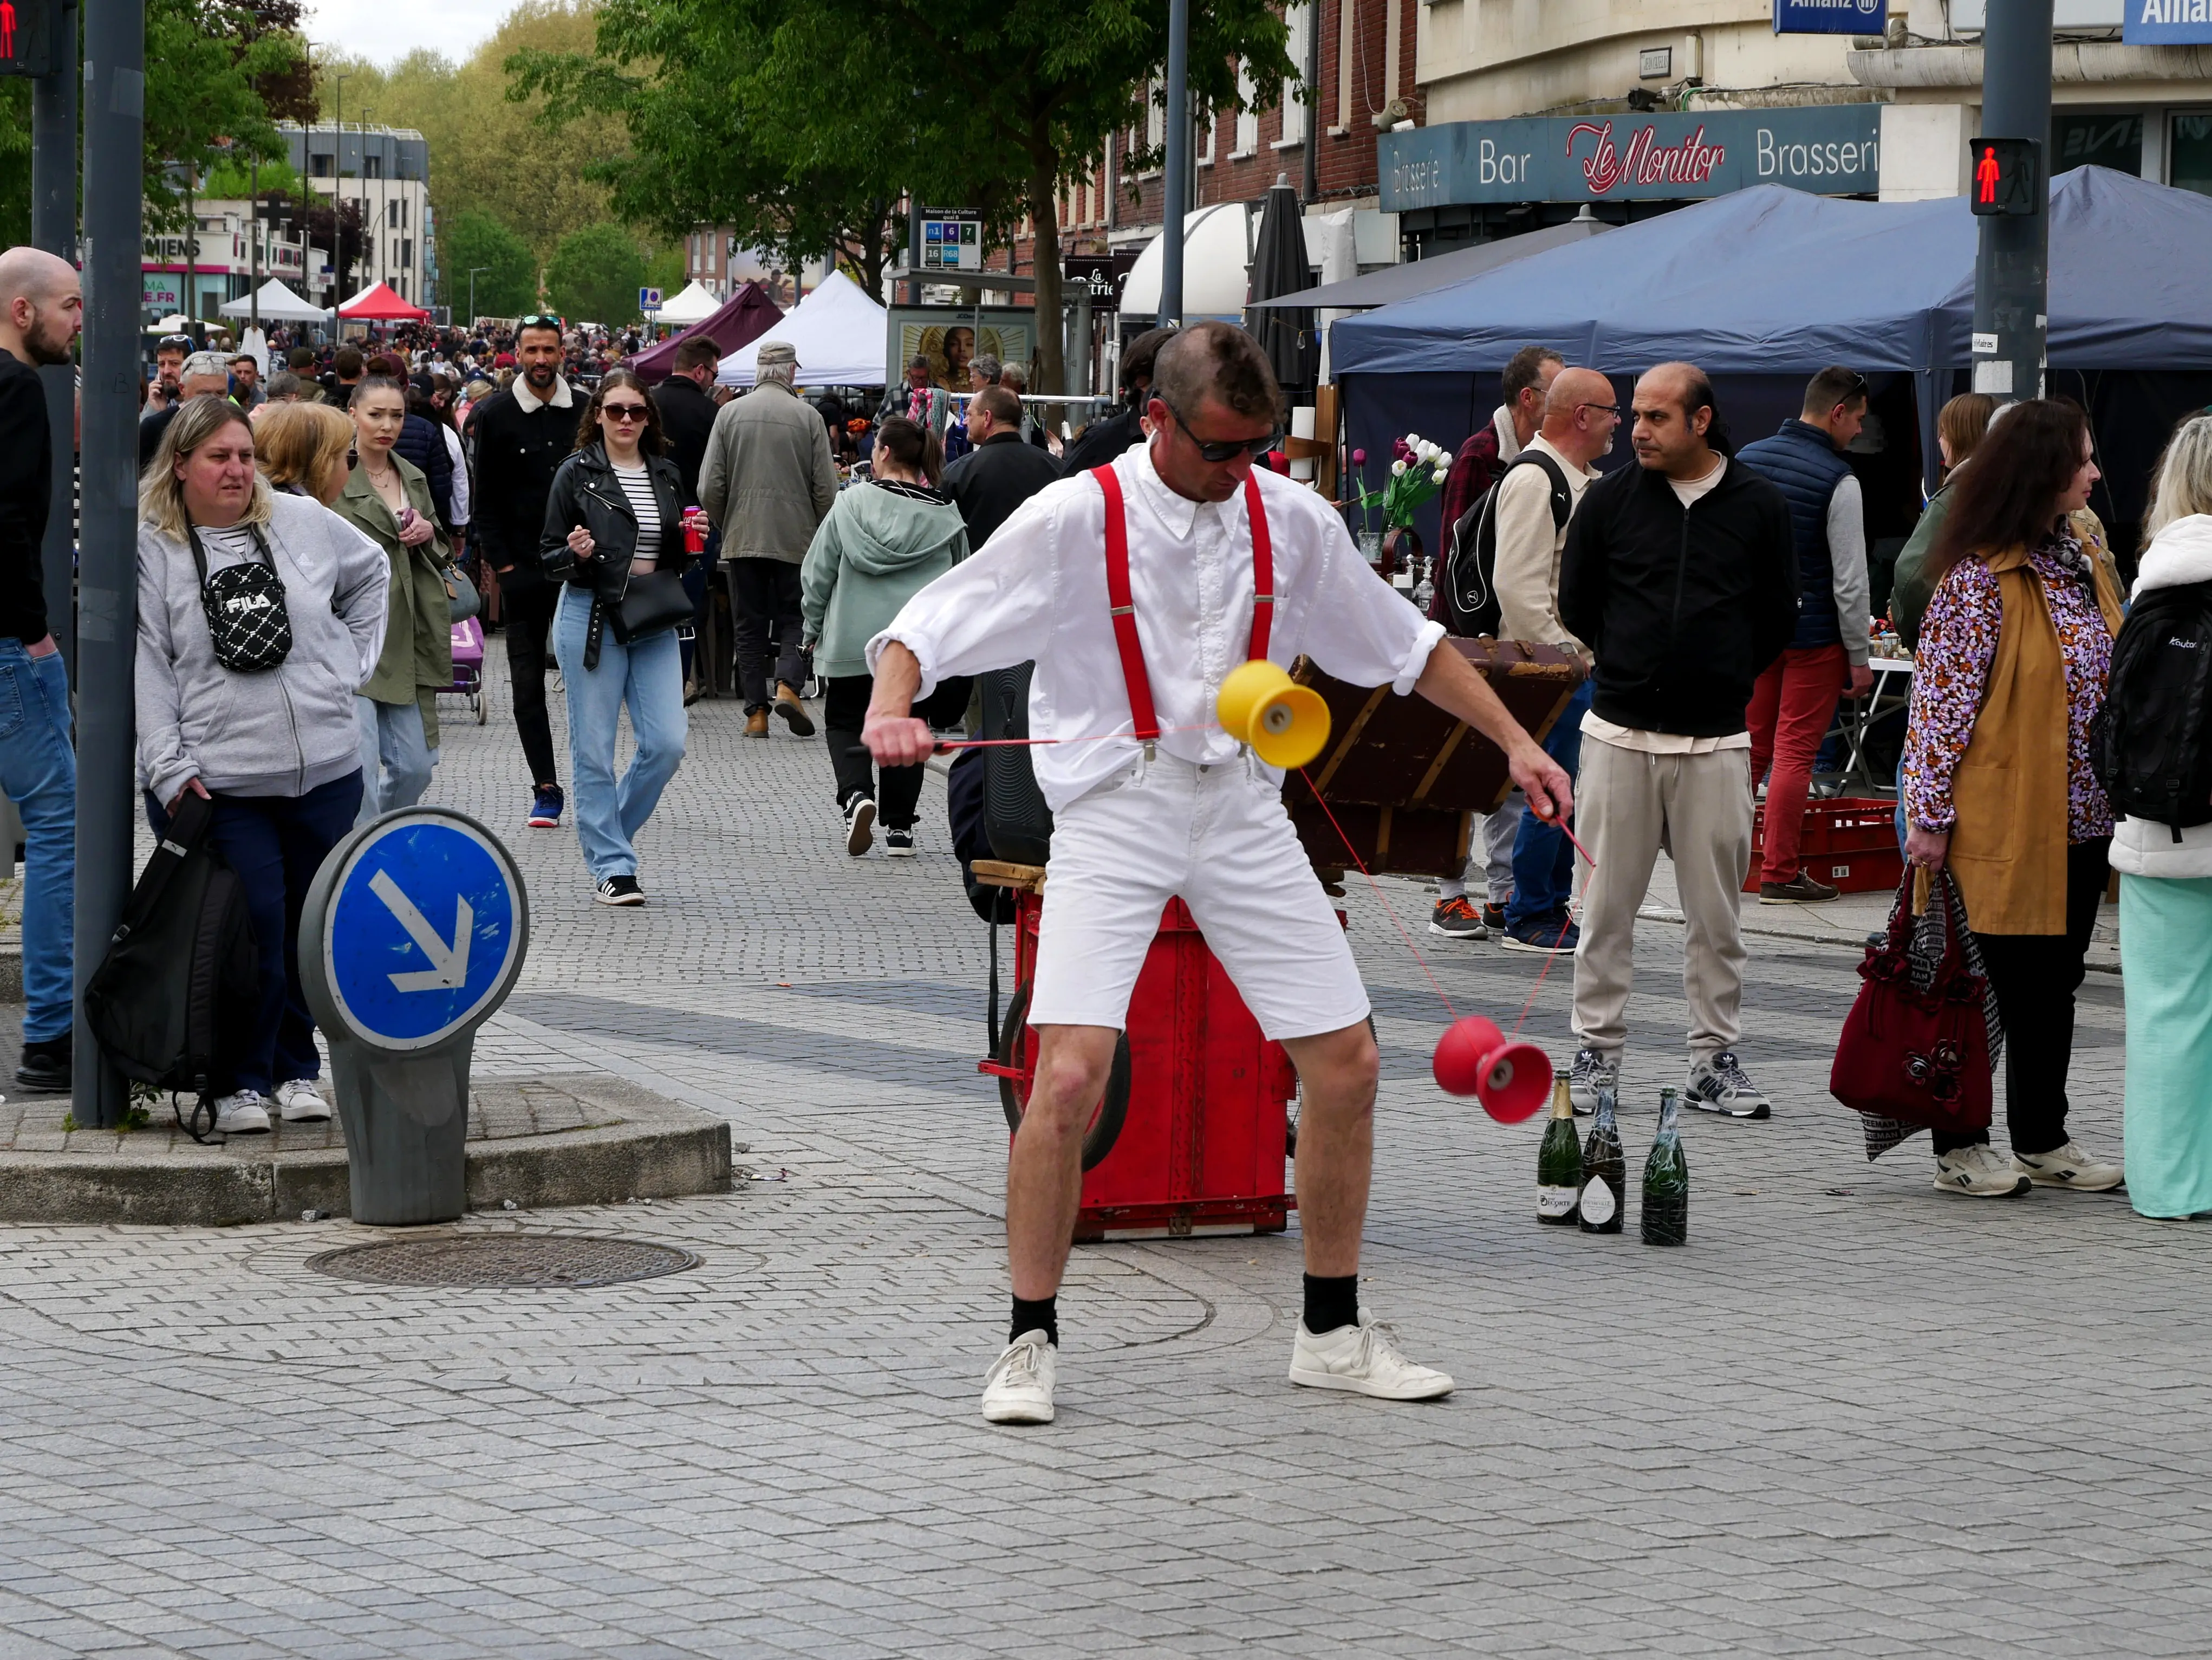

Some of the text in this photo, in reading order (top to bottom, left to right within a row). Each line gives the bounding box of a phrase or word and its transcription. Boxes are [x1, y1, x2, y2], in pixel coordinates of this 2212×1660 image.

[2141, 0, 2212, 23] Allia
[1393, 120, 1878, 194] Brasserie Bar Le Monitor Brasseri
[928, 227, 940, 235] n1
[966, 228, 972, 236] 7
[943, 250, 958, 258] R68
[1088, 268, 1105, 283] La
[226, 593, 271, 613] FILA
